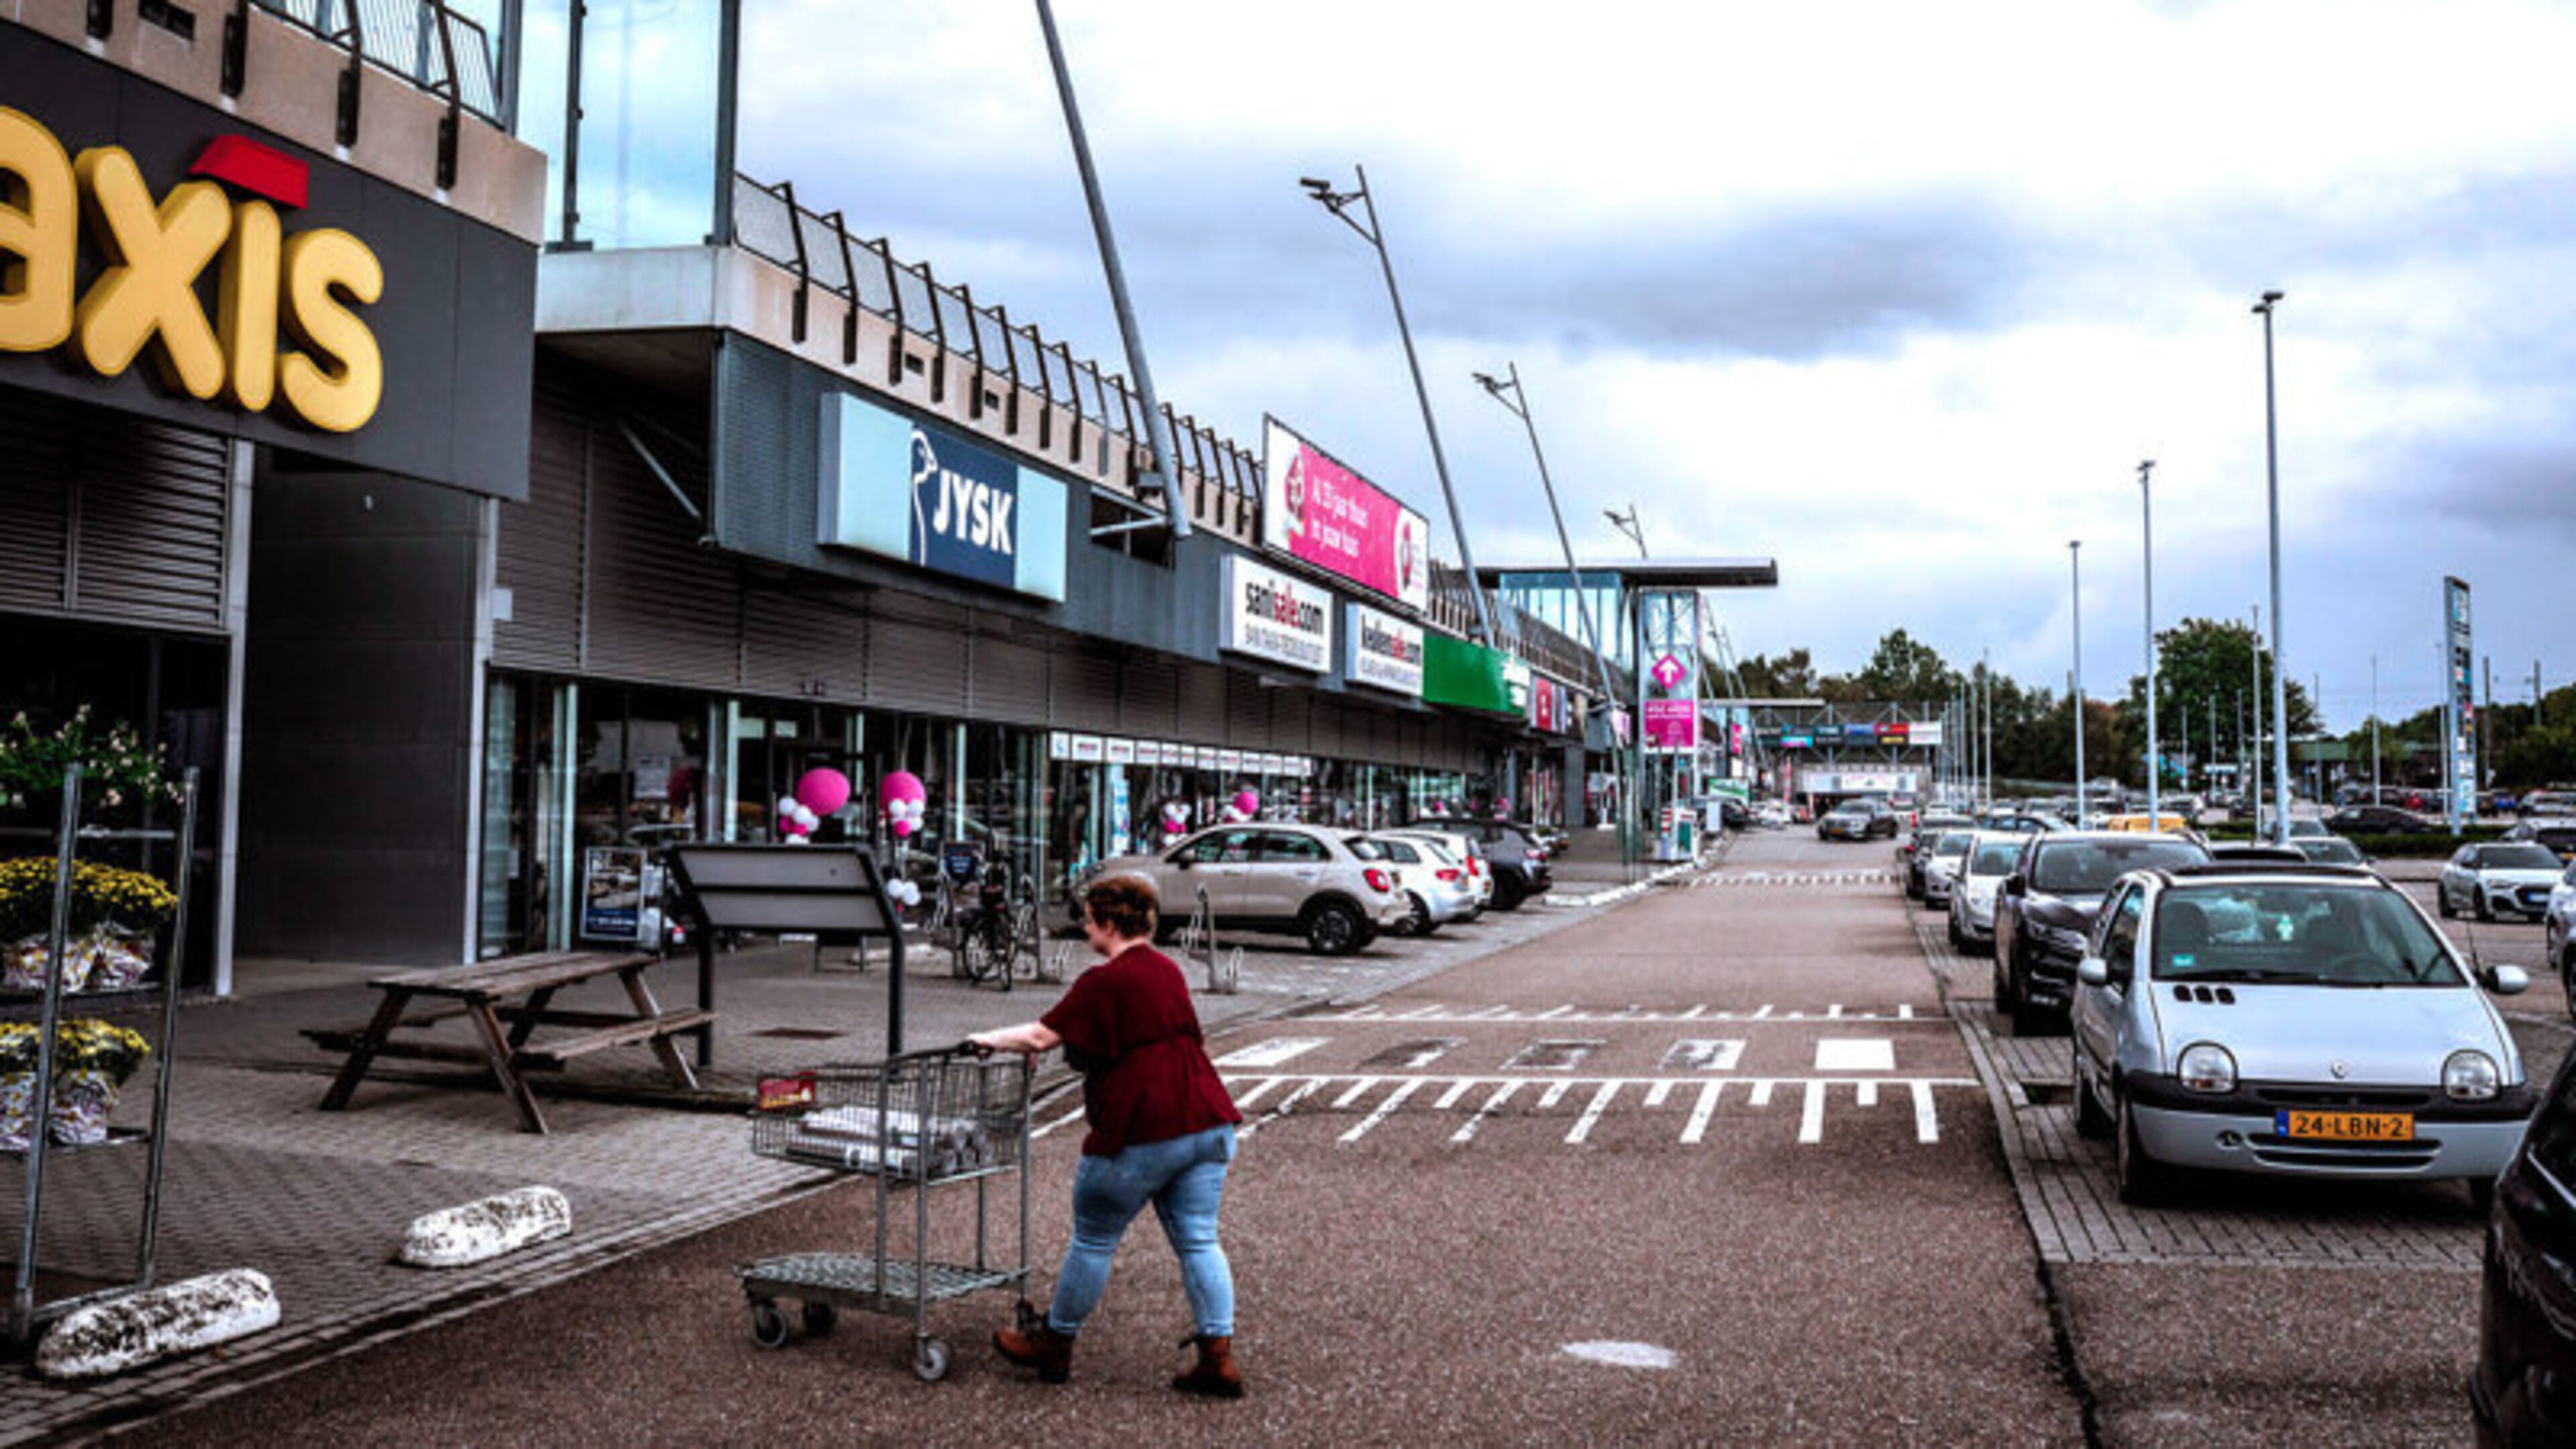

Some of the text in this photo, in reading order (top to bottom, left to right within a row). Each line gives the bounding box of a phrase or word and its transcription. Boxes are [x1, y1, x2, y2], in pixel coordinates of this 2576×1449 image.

[0, 105, 384, 433] axis
[933, 469, 1014, 555] JYSK
[1246, 579, 1324, 636] sanisale.com
[2295, 1114, 2404, 1137] 24-LBN-2
